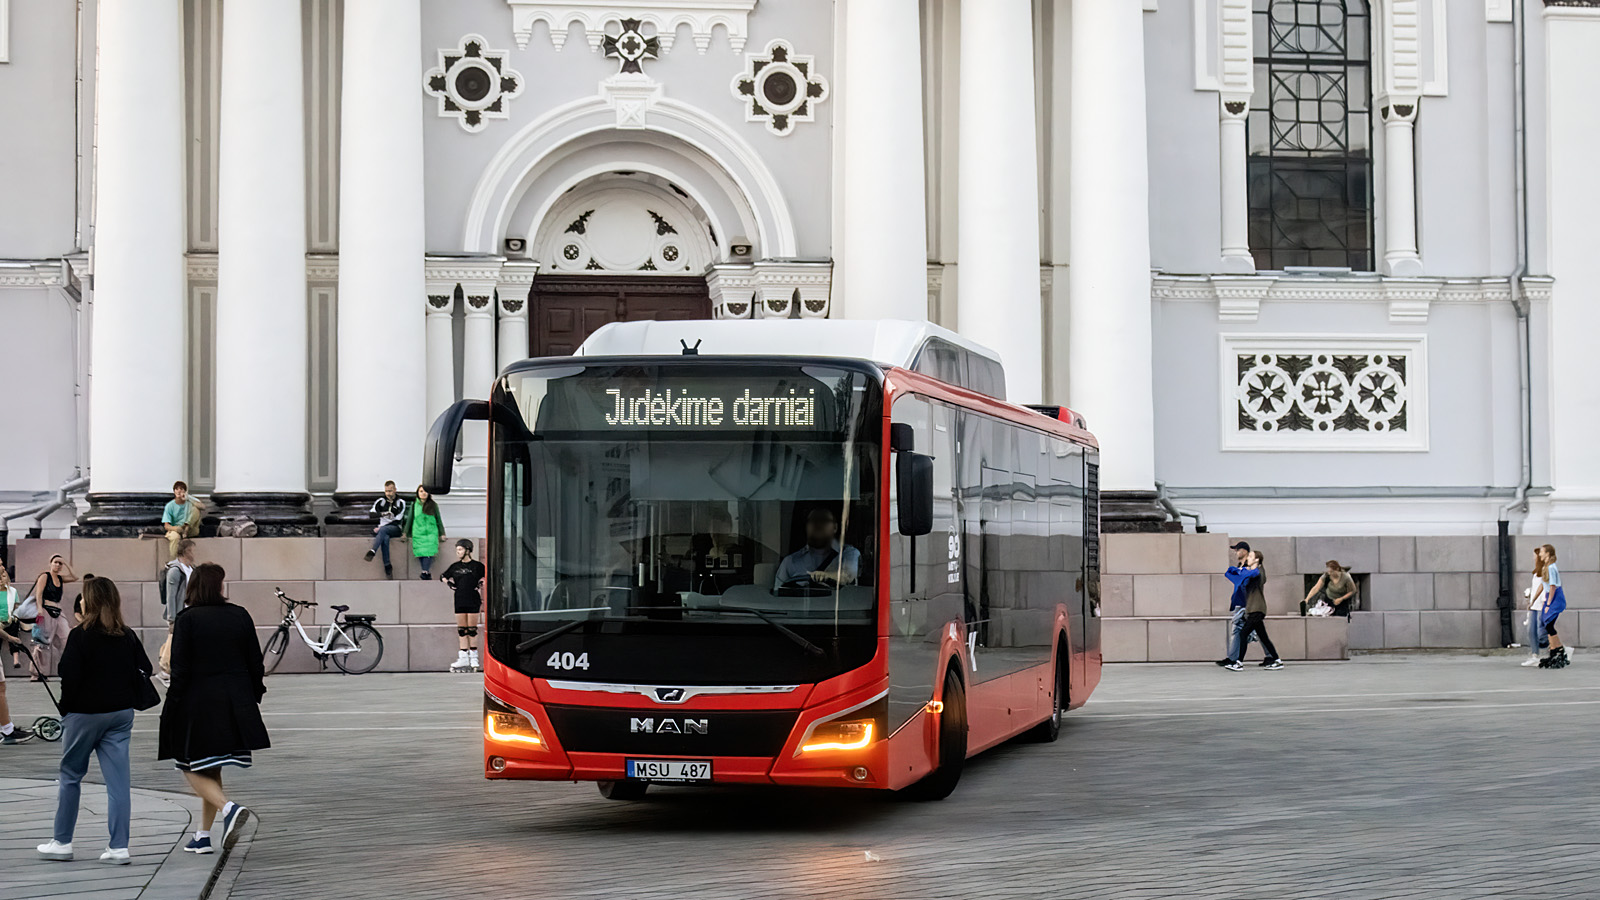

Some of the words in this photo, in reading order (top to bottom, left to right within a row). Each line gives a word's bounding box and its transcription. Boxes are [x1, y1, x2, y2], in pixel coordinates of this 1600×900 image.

[605, 388, 724, 426] Judėkime
[732, 388, 815, 426] darniai
[546, 651, 590, 670] 404
[630, 717, 708, 734] MAN
[636, 763, 670, 777] MSU
[680, 763, 708, 778] 487
